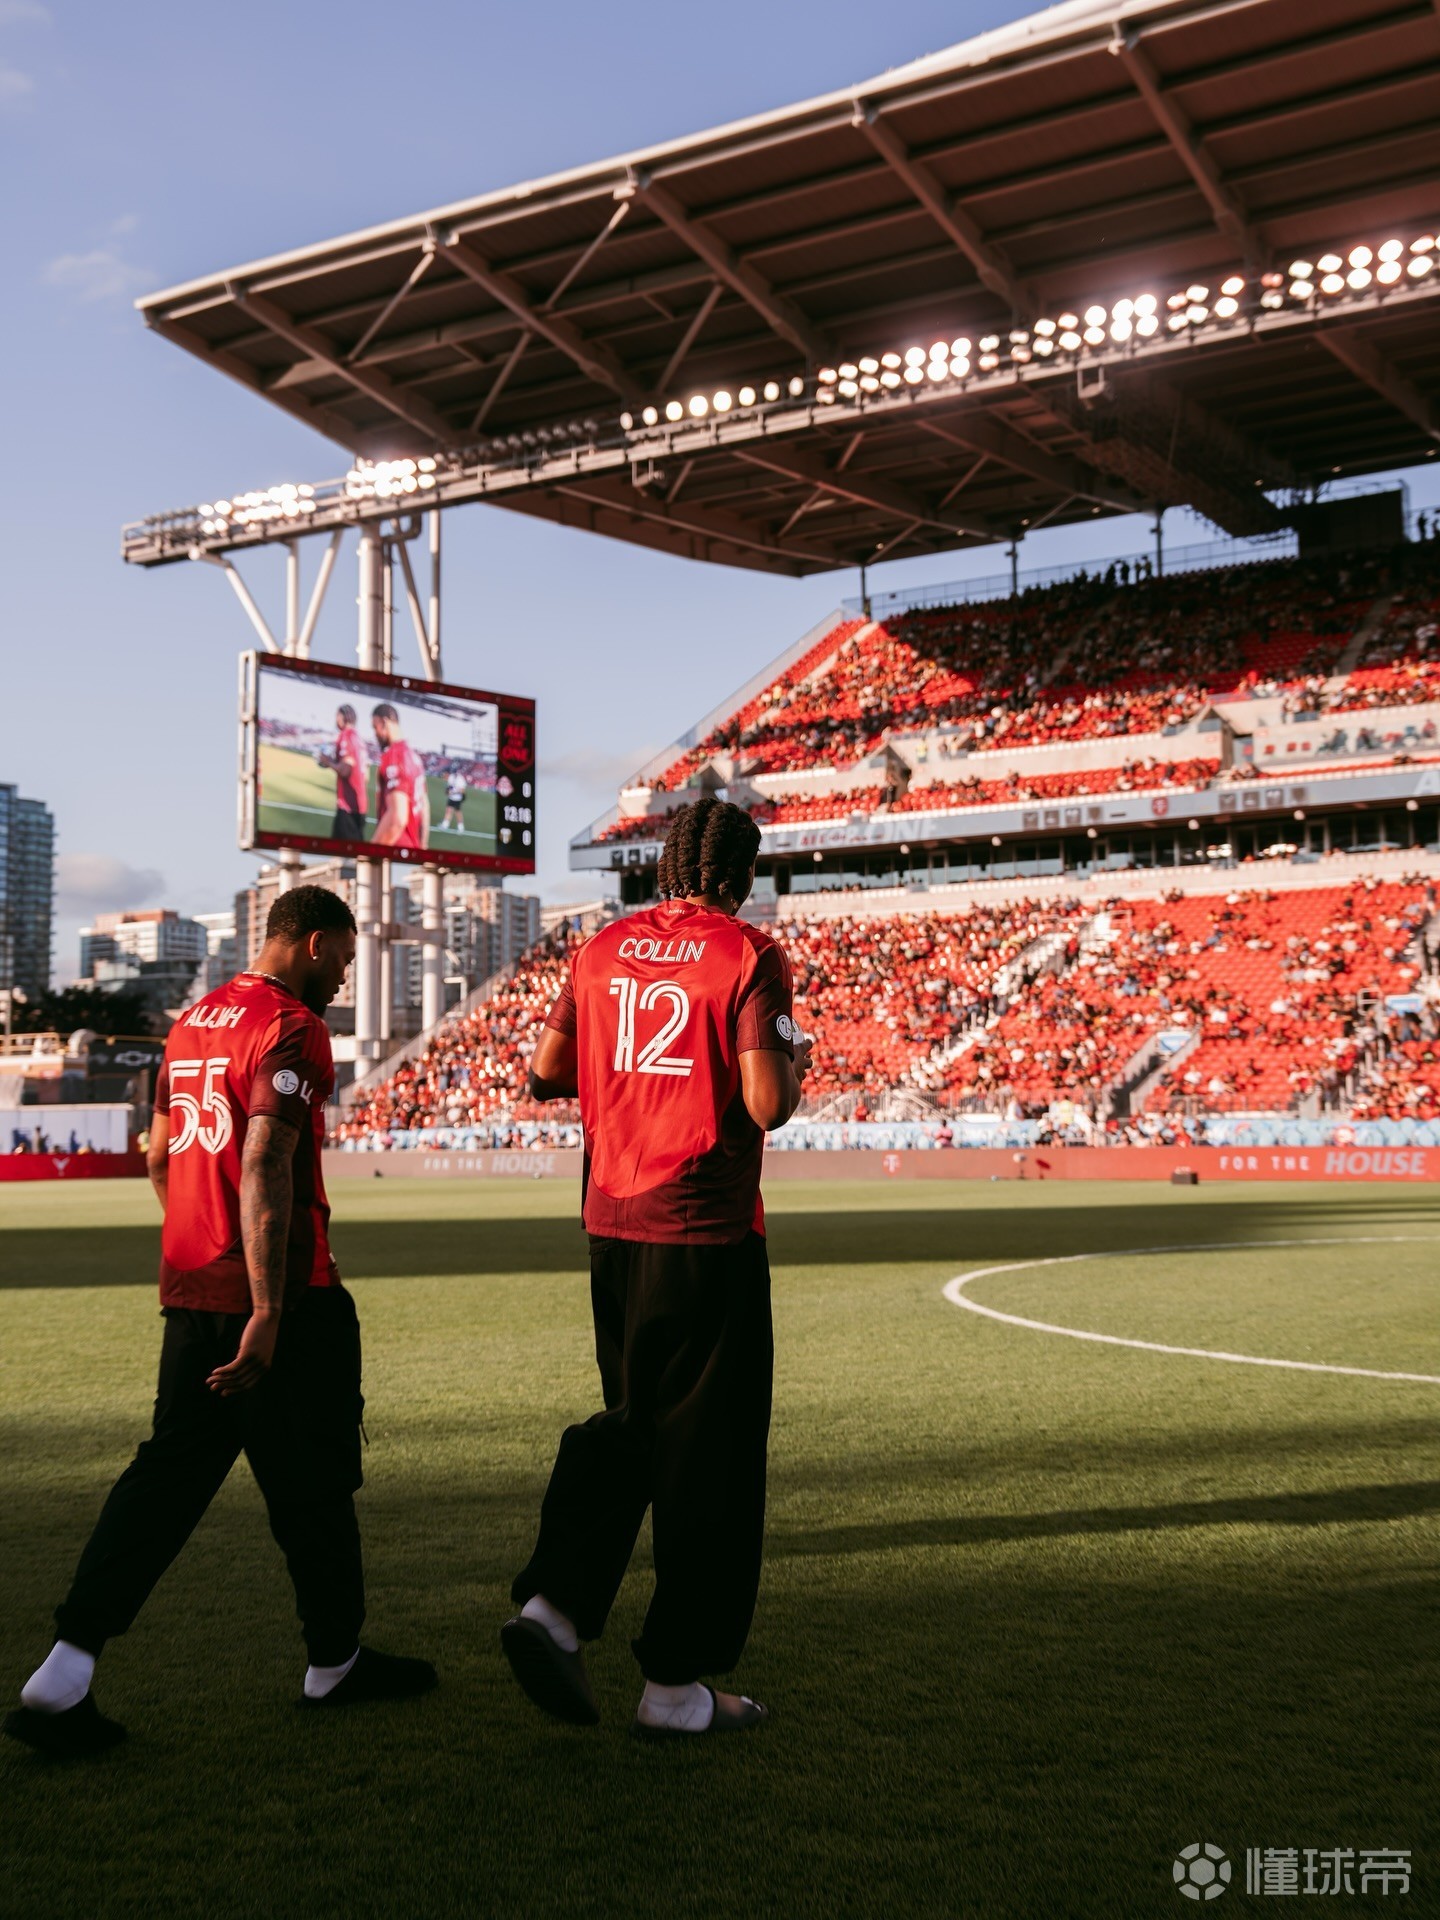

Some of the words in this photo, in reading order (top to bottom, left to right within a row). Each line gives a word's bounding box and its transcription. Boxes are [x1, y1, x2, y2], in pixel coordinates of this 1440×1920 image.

[618, 937, 706, 963] COLLIN
[609, 977, 695, 1077] 12
[168, 1057, 233, 1155] 55
[492, 1153, 557, 1174] HOUSE
[1219, 1156, 1258, 1171] FOR
[1272, 1156, 1310, 1171] THE
[1324, 1151, 1427, 1175] HOUSE
